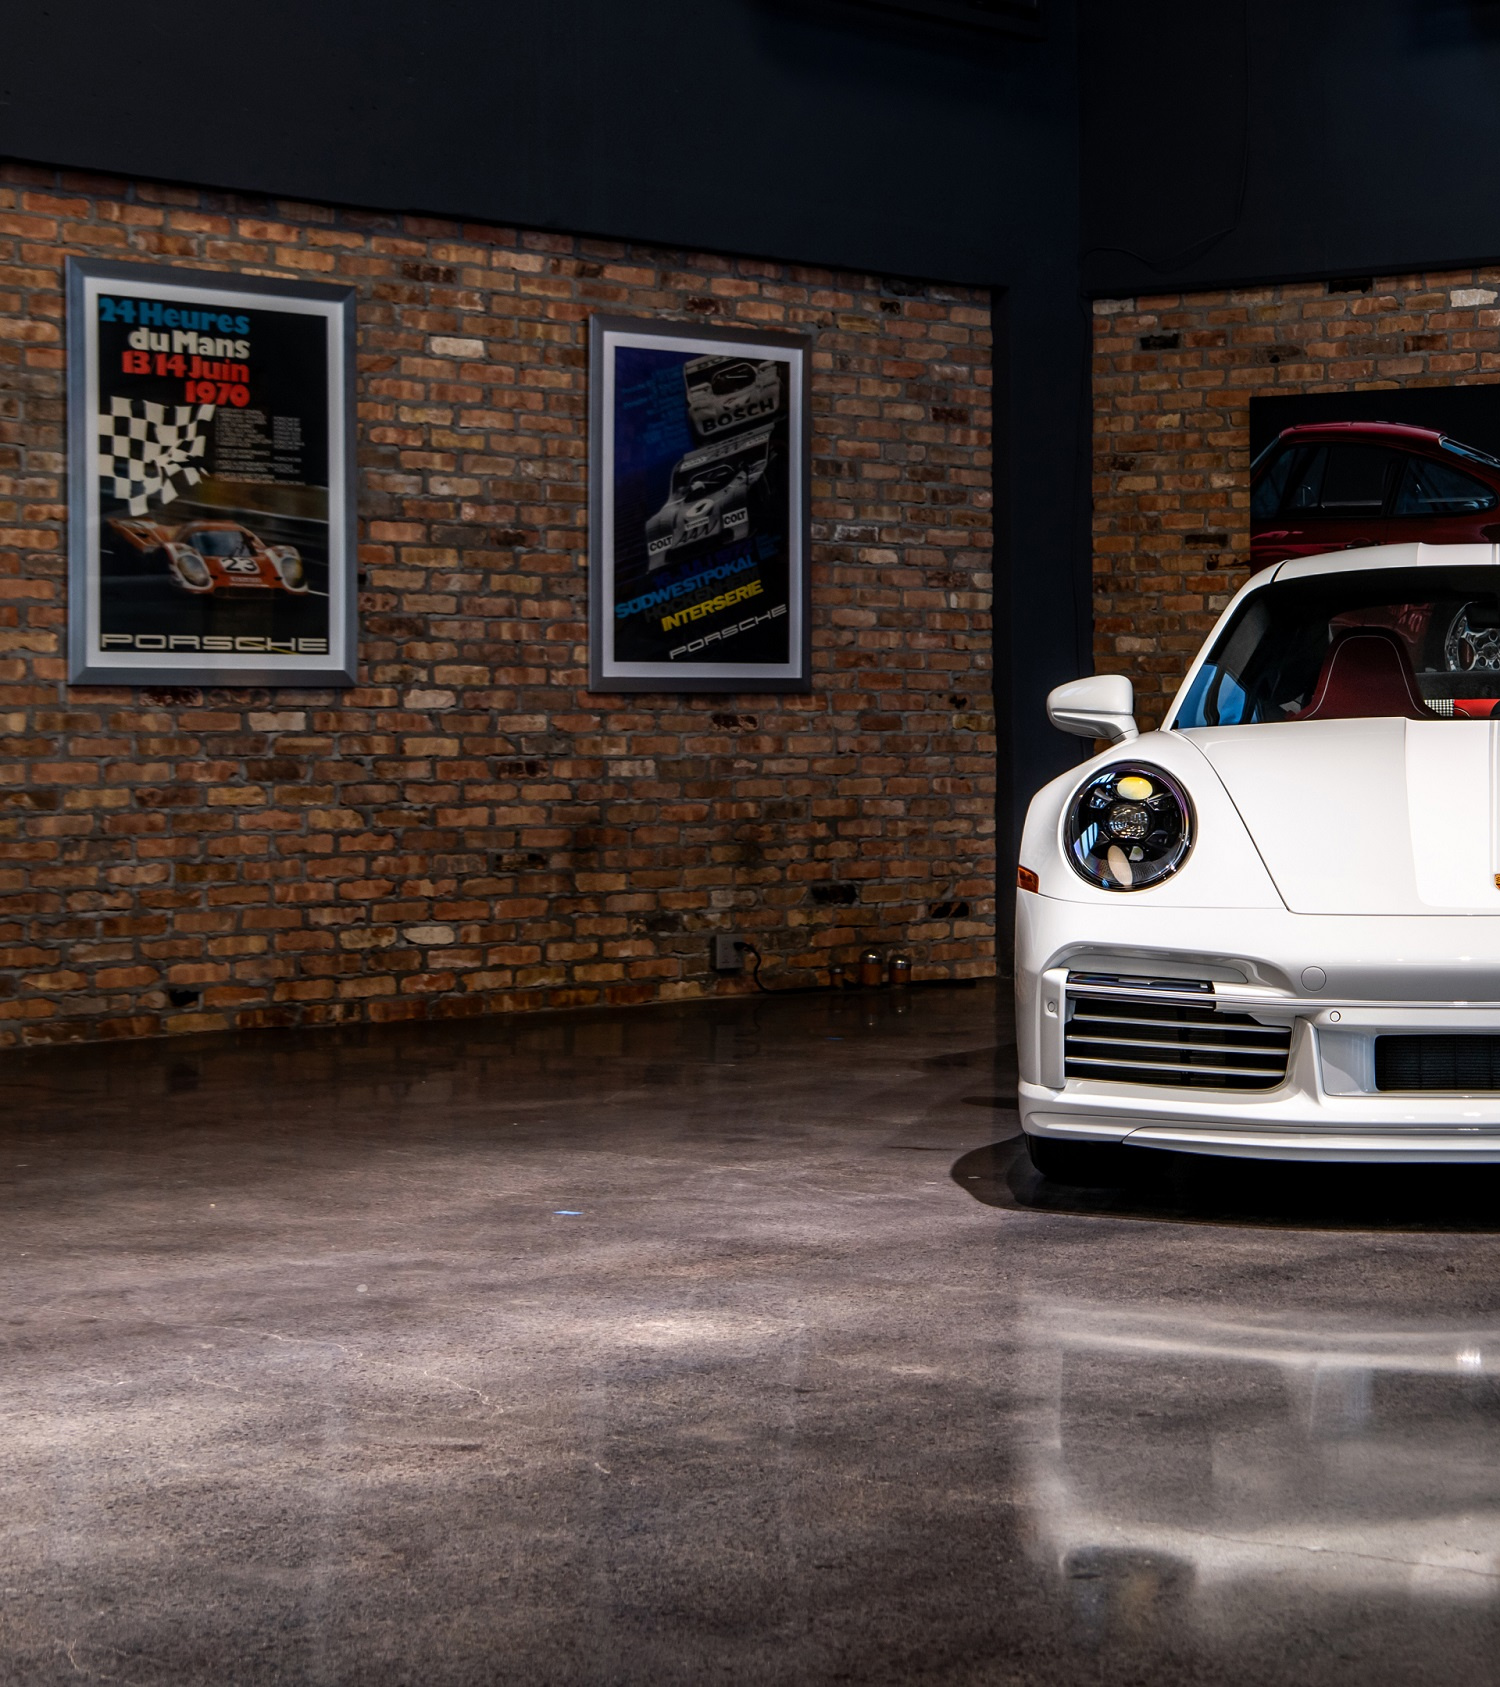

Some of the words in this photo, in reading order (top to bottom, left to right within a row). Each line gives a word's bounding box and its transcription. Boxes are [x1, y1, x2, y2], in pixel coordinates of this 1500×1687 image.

[100, 298, 137, 323] 24
[139, 302, 250, 335] Heures
[129, 327, 170, 353] du
[172, 330, 250, 359] Mans
[188, 358, 250, 383] Juin
[185, 380, 250, 407] 1970
[702, 397, 775, 432] BOSCH
[724, 511, 746, 526] COLT
[650, 536, 673, 552] COLT
[221, 557, 258, 572] 23
[661, 579, 764, 632] INTERSERIE
[101, 634, 328, 651] PORSCHE
[669, 604, 787, 659] PORSCHE
